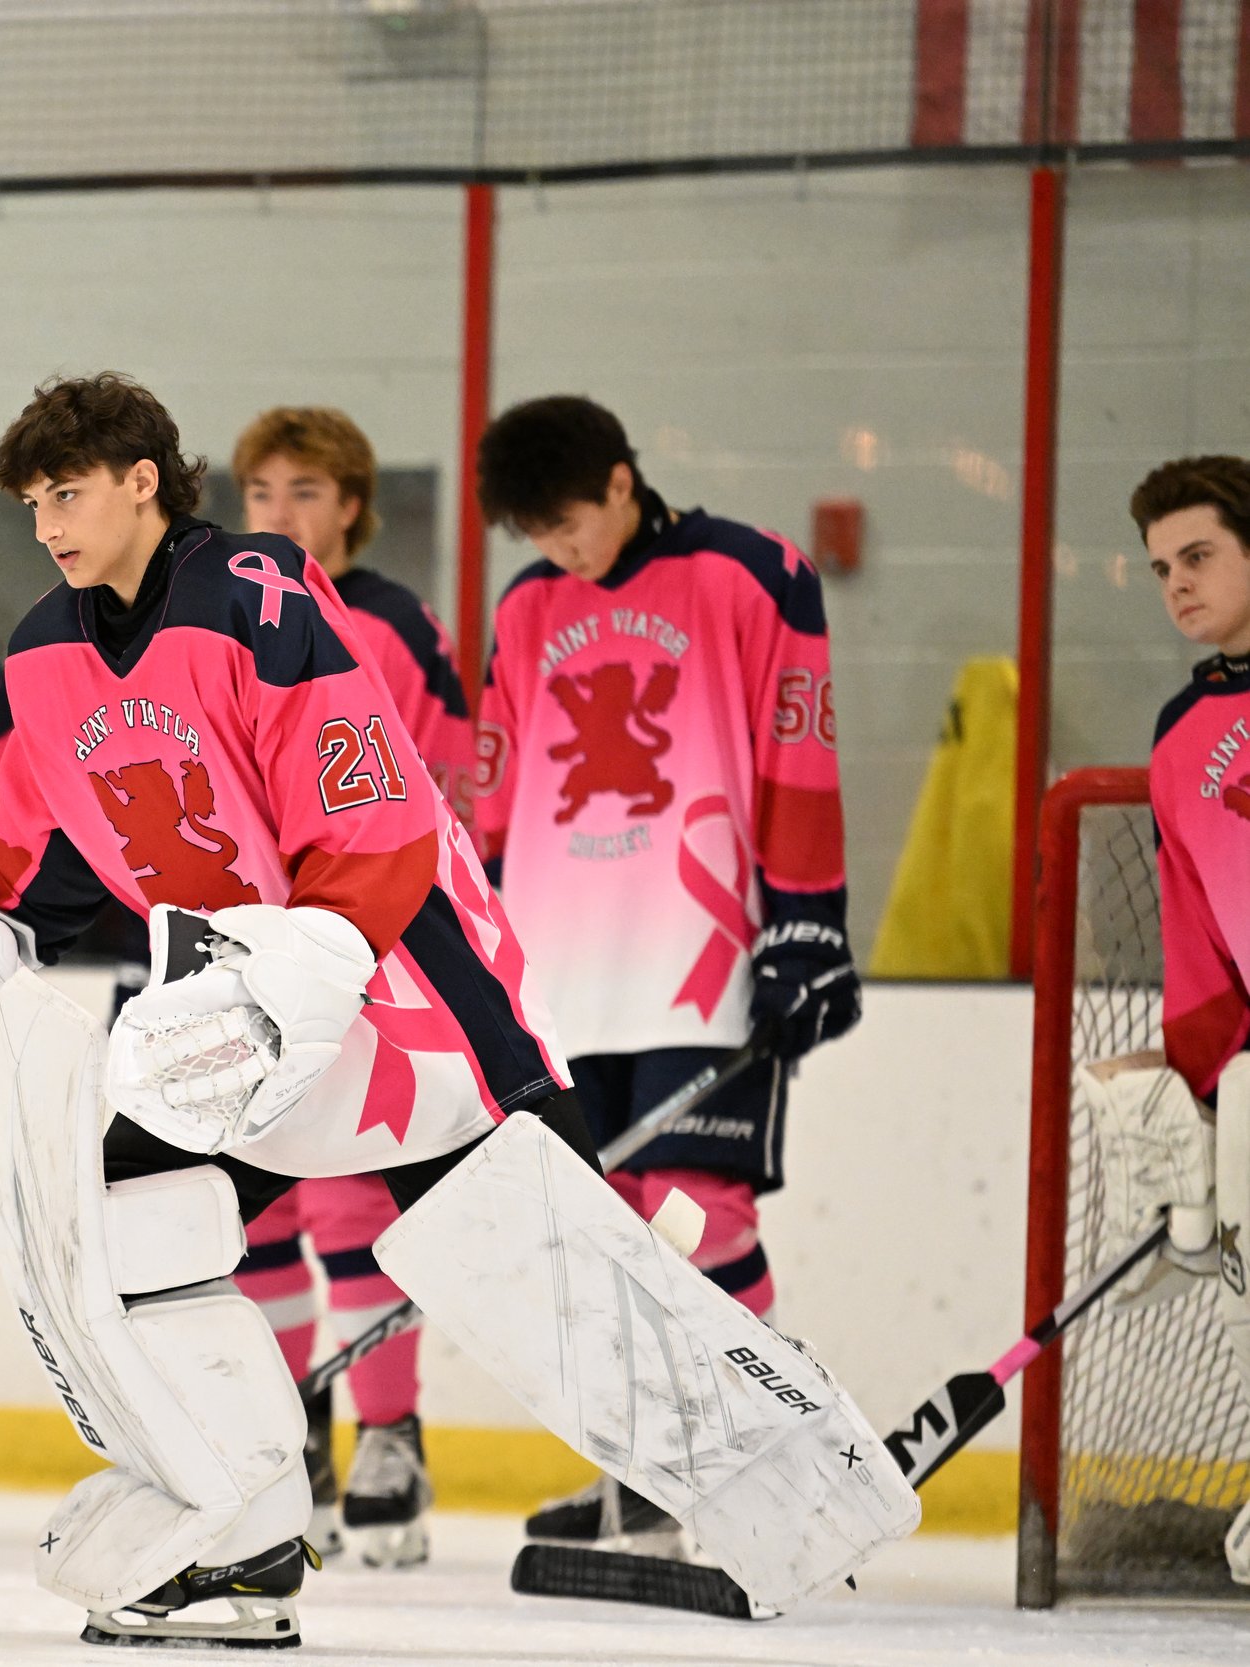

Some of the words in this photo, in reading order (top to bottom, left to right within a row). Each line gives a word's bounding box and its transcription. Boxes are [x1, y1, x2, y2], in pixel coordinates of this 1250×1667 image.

[316, 715, 407, 816] 21
[1199, 716, 1250, 799] SAINT
[19, 1307, 108, 1451] BAUER
[724, 1346, 822, 1416] BAUER
